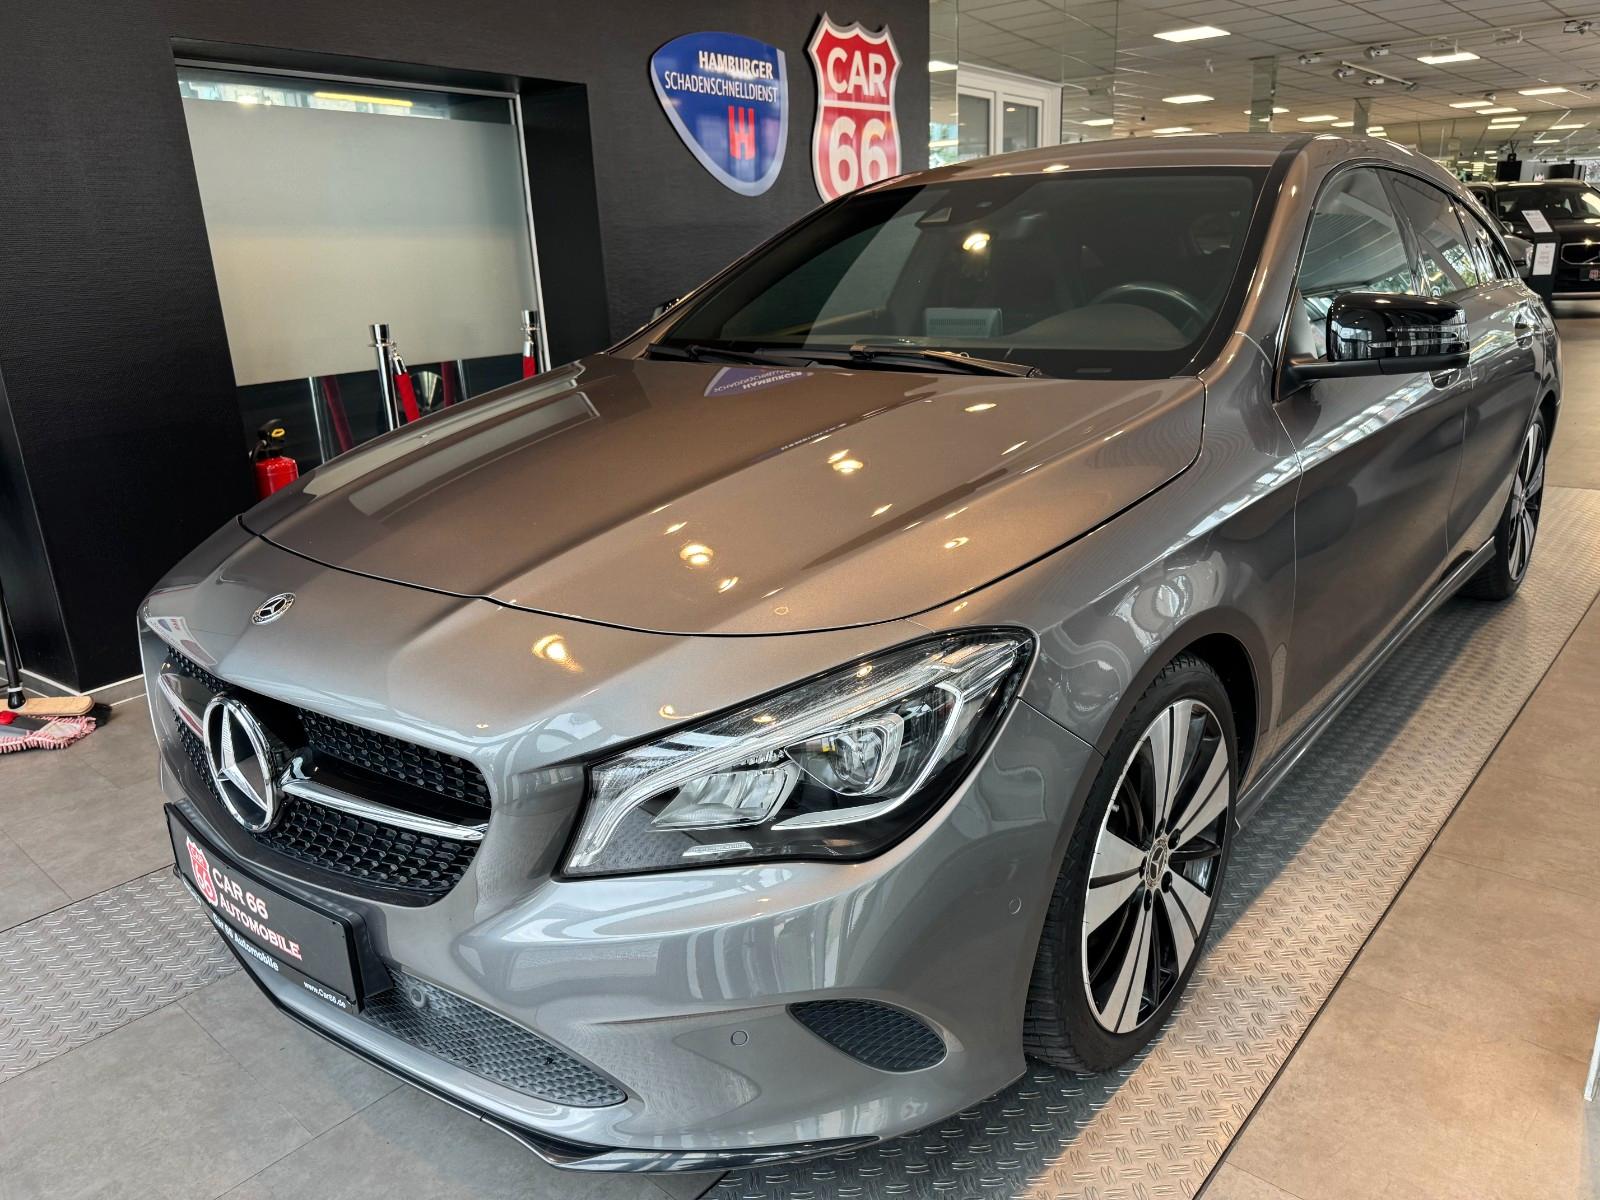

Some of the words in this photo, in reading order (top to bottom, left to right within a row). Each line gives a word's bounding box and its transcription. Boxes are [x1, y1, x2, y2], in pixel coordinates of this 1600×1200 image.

[664, 70, 778, 102] SCHADENSCHNELLDIENST
[698, 50, 773, 79] HAMBURGER
[827, 47, 887, 97] CAR
[829, 116, 888, 195] 66
[212, 867, 246, 906] CAR
[245, 891, 269, 919] 66
[219, 892, 302, 961] AUTOMOBILE
